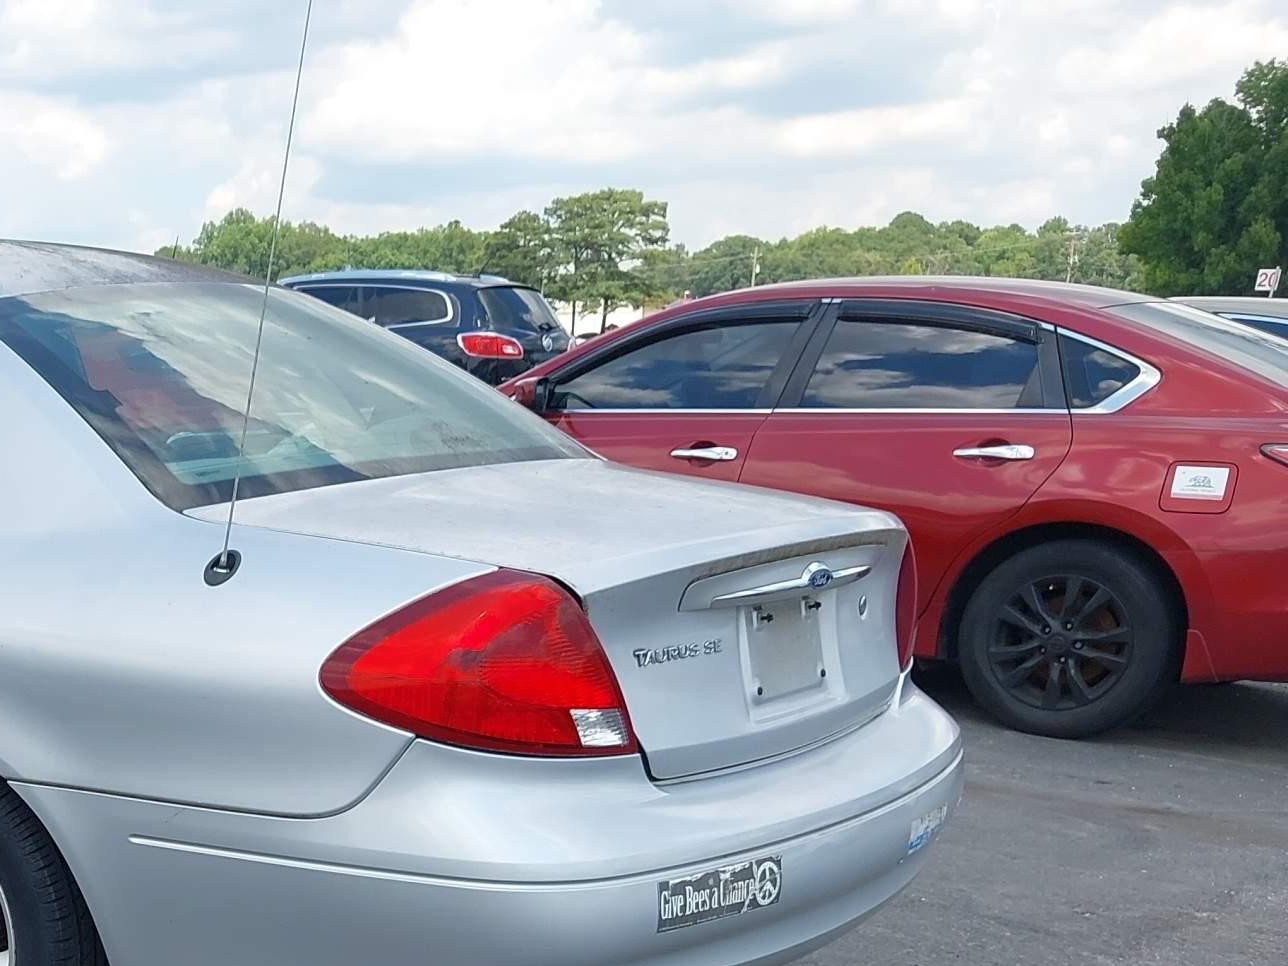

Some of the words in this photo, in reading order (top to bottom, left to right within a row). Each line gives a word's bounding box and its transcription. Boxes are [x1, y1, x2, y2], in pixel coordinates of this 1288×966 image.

[633, 643, 700, 667] TAURUS
[703, 639, 723, 655] SE
[661, 891, 684, 920] Give
[685, 886, 710, 915] Bees
[712, 887, 718, 909] a
